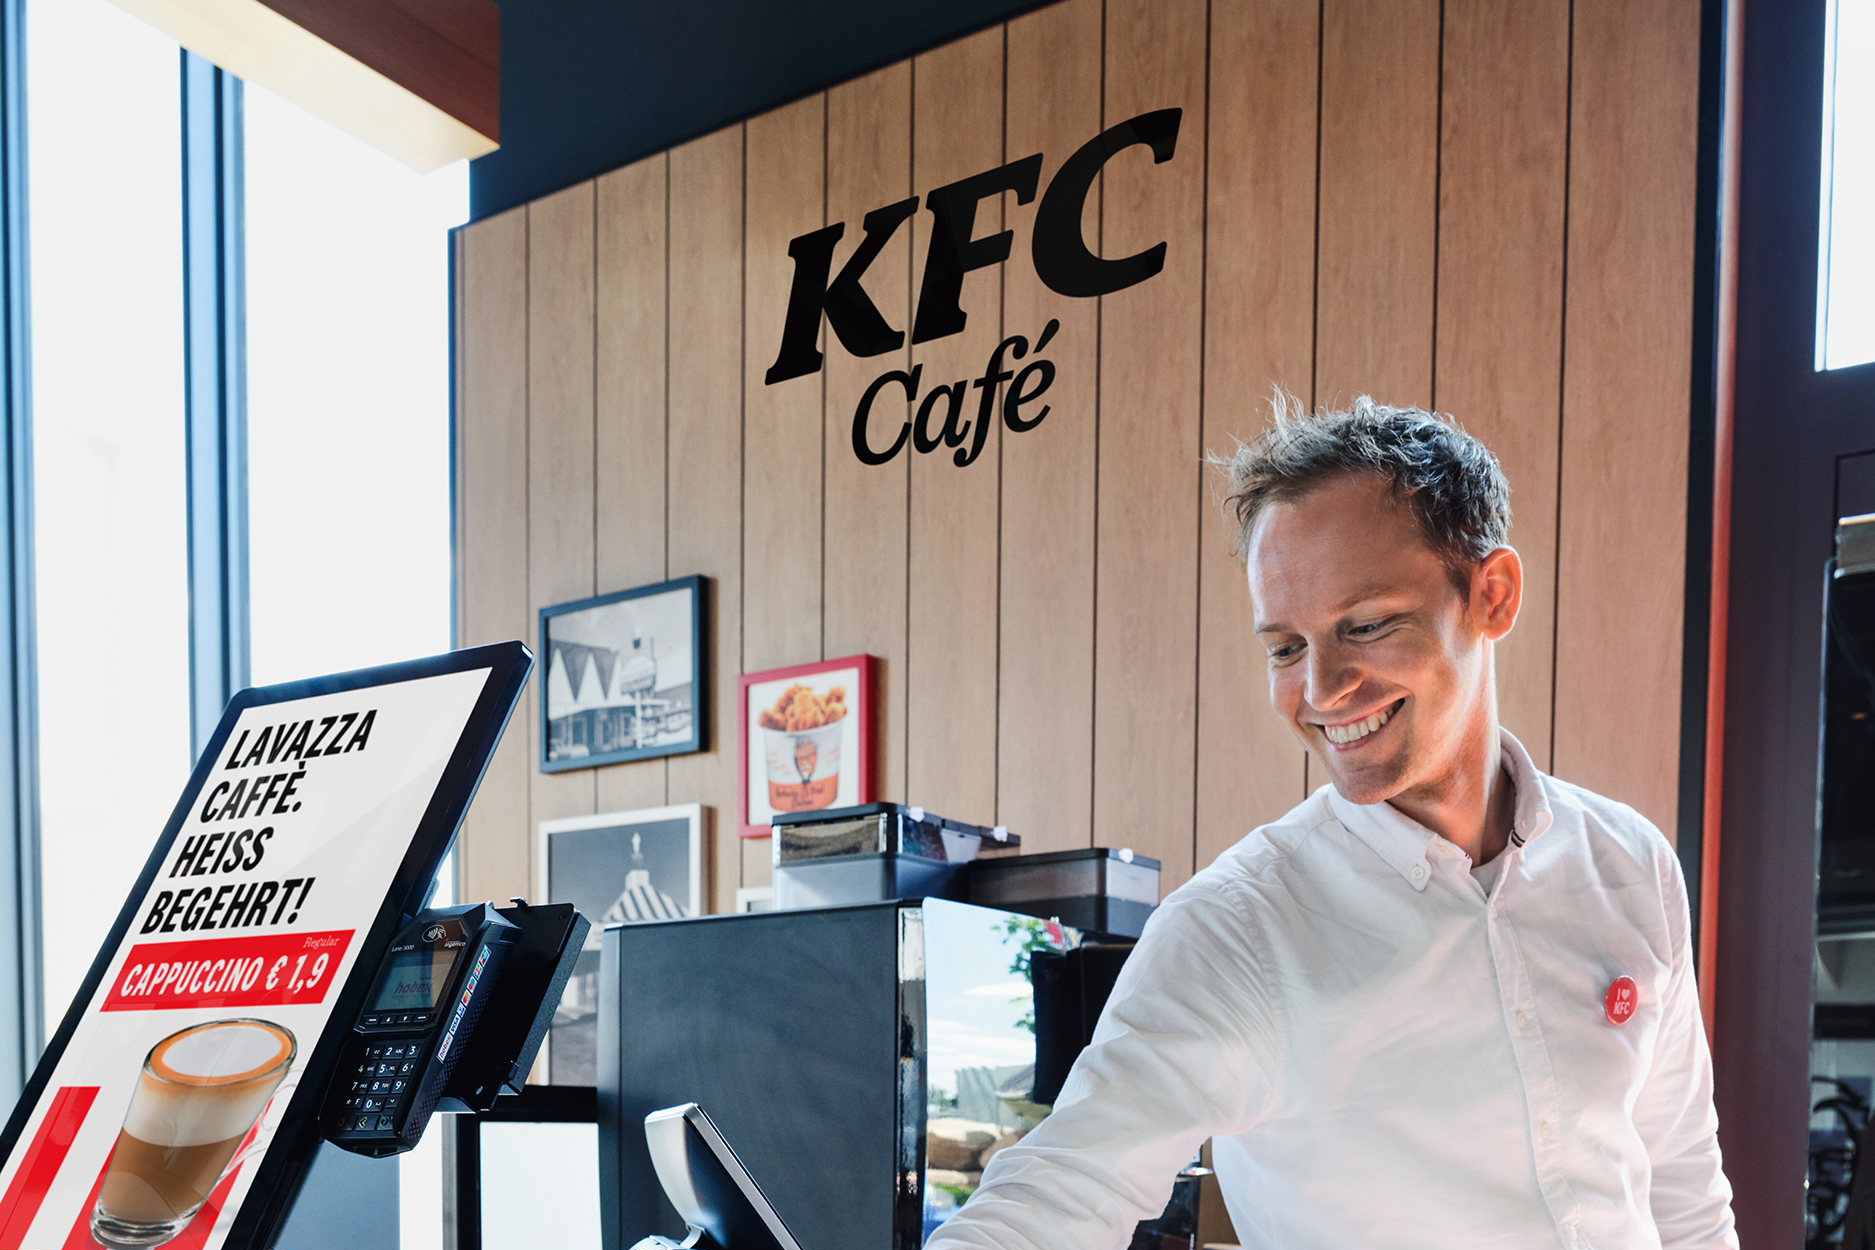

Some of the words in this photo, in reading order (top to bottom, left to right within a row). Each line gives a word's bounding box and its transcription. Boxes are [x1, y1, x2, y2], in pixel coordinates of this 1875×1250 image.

[765, 107, 1183, 386] KFC
[851, 318, 1060, 468] Café
[224, 709, 377, 770] LAVAZZA
[168, 827, 274, 878] HEISS
[139, 877, 316, 934] BEGEHRT!
[303, 934, 340, 950] Regular
[120, 956, 265, 997] CAPPUCCINO
[265, 955, 288, 990] €
[287, 952, 330, 994] 1,9
[394, 981, 434, 994] hobex
[1613, 1001, 1631, 1015] KFC
[385, 1047, 393, 1056] 2
[409, 1045, 416, 1055] 3
[379, 1063, 386, 1074] 5
[402, 1062, 409, 1072] 6
[351, 1081, 358, 1090] 7
[372, 1081, 380, 1091] 8
[395, 1080, 402, 1090] 9
